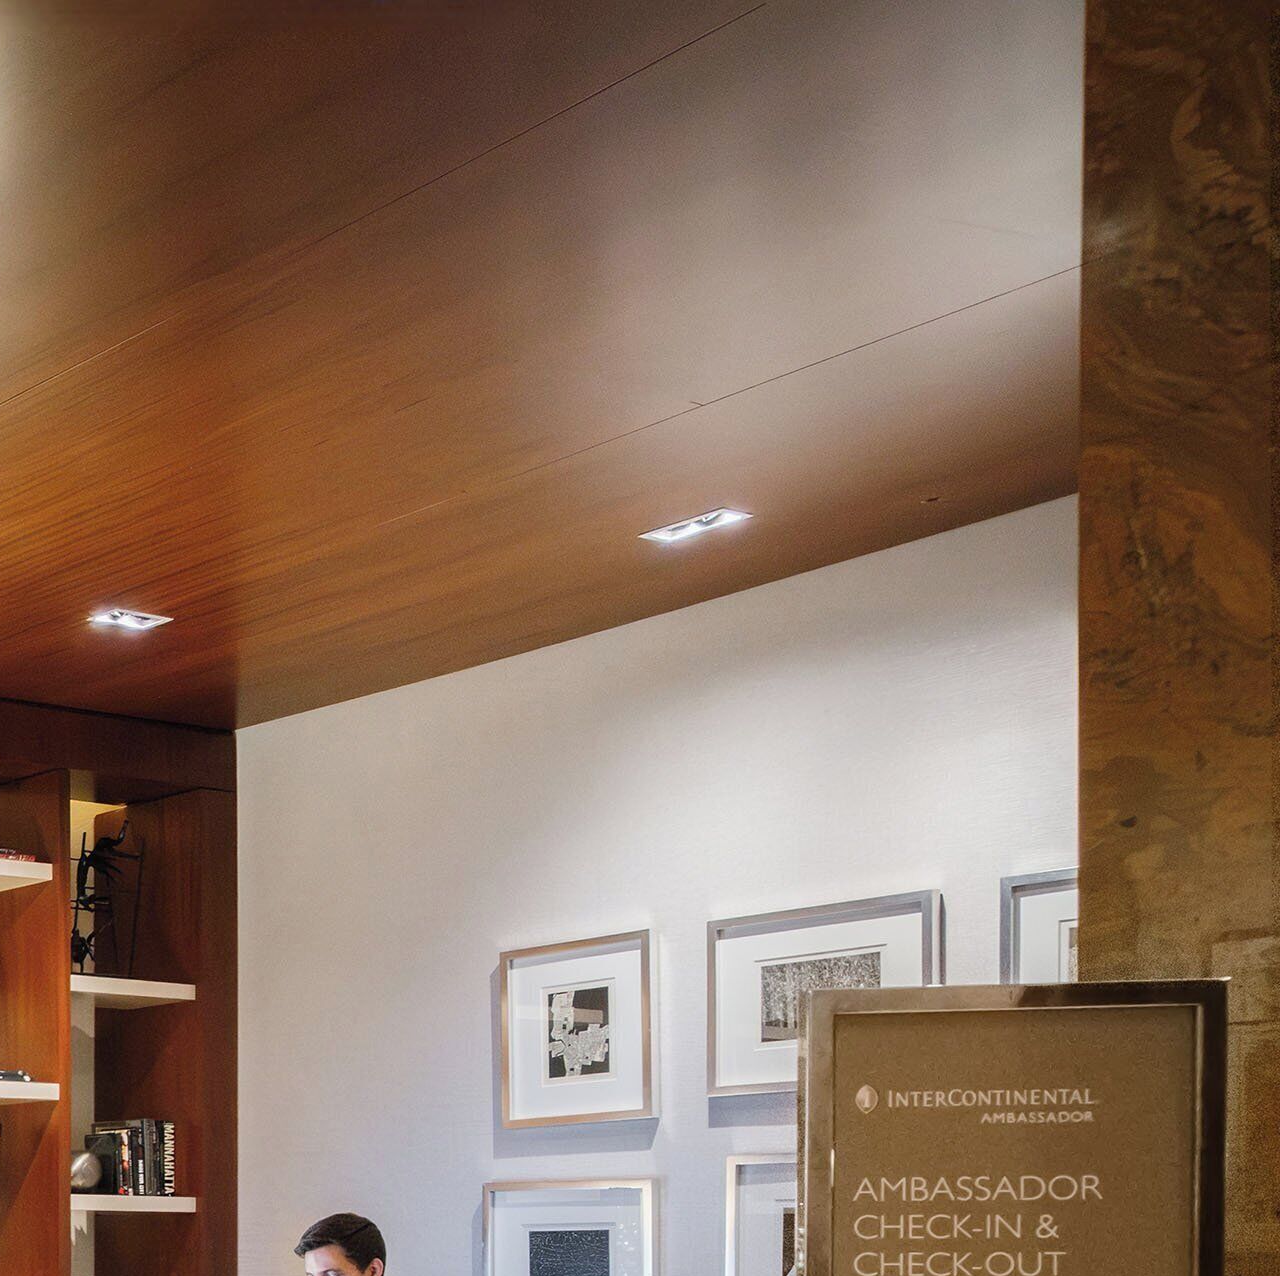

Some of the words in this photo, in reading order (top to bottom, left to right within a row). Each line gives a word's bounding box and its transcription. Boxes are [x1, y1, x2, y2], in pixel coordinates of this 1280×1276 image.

[887, 1088, 1095, 1108] INTERCONTINENTAL
[980, 1111, 1094, 1124] AMBASSADOR
[164, 1123, 175, 1194] MANNAHATTA
[853, 1175, 1103, 1202] AMBASSADOR
[853, 1214, 1022, 1240] CHECK-IN
[1035, 1214, 1059, 1239] &
[853, 1251, 1067, 1276] CHECK-OUT
